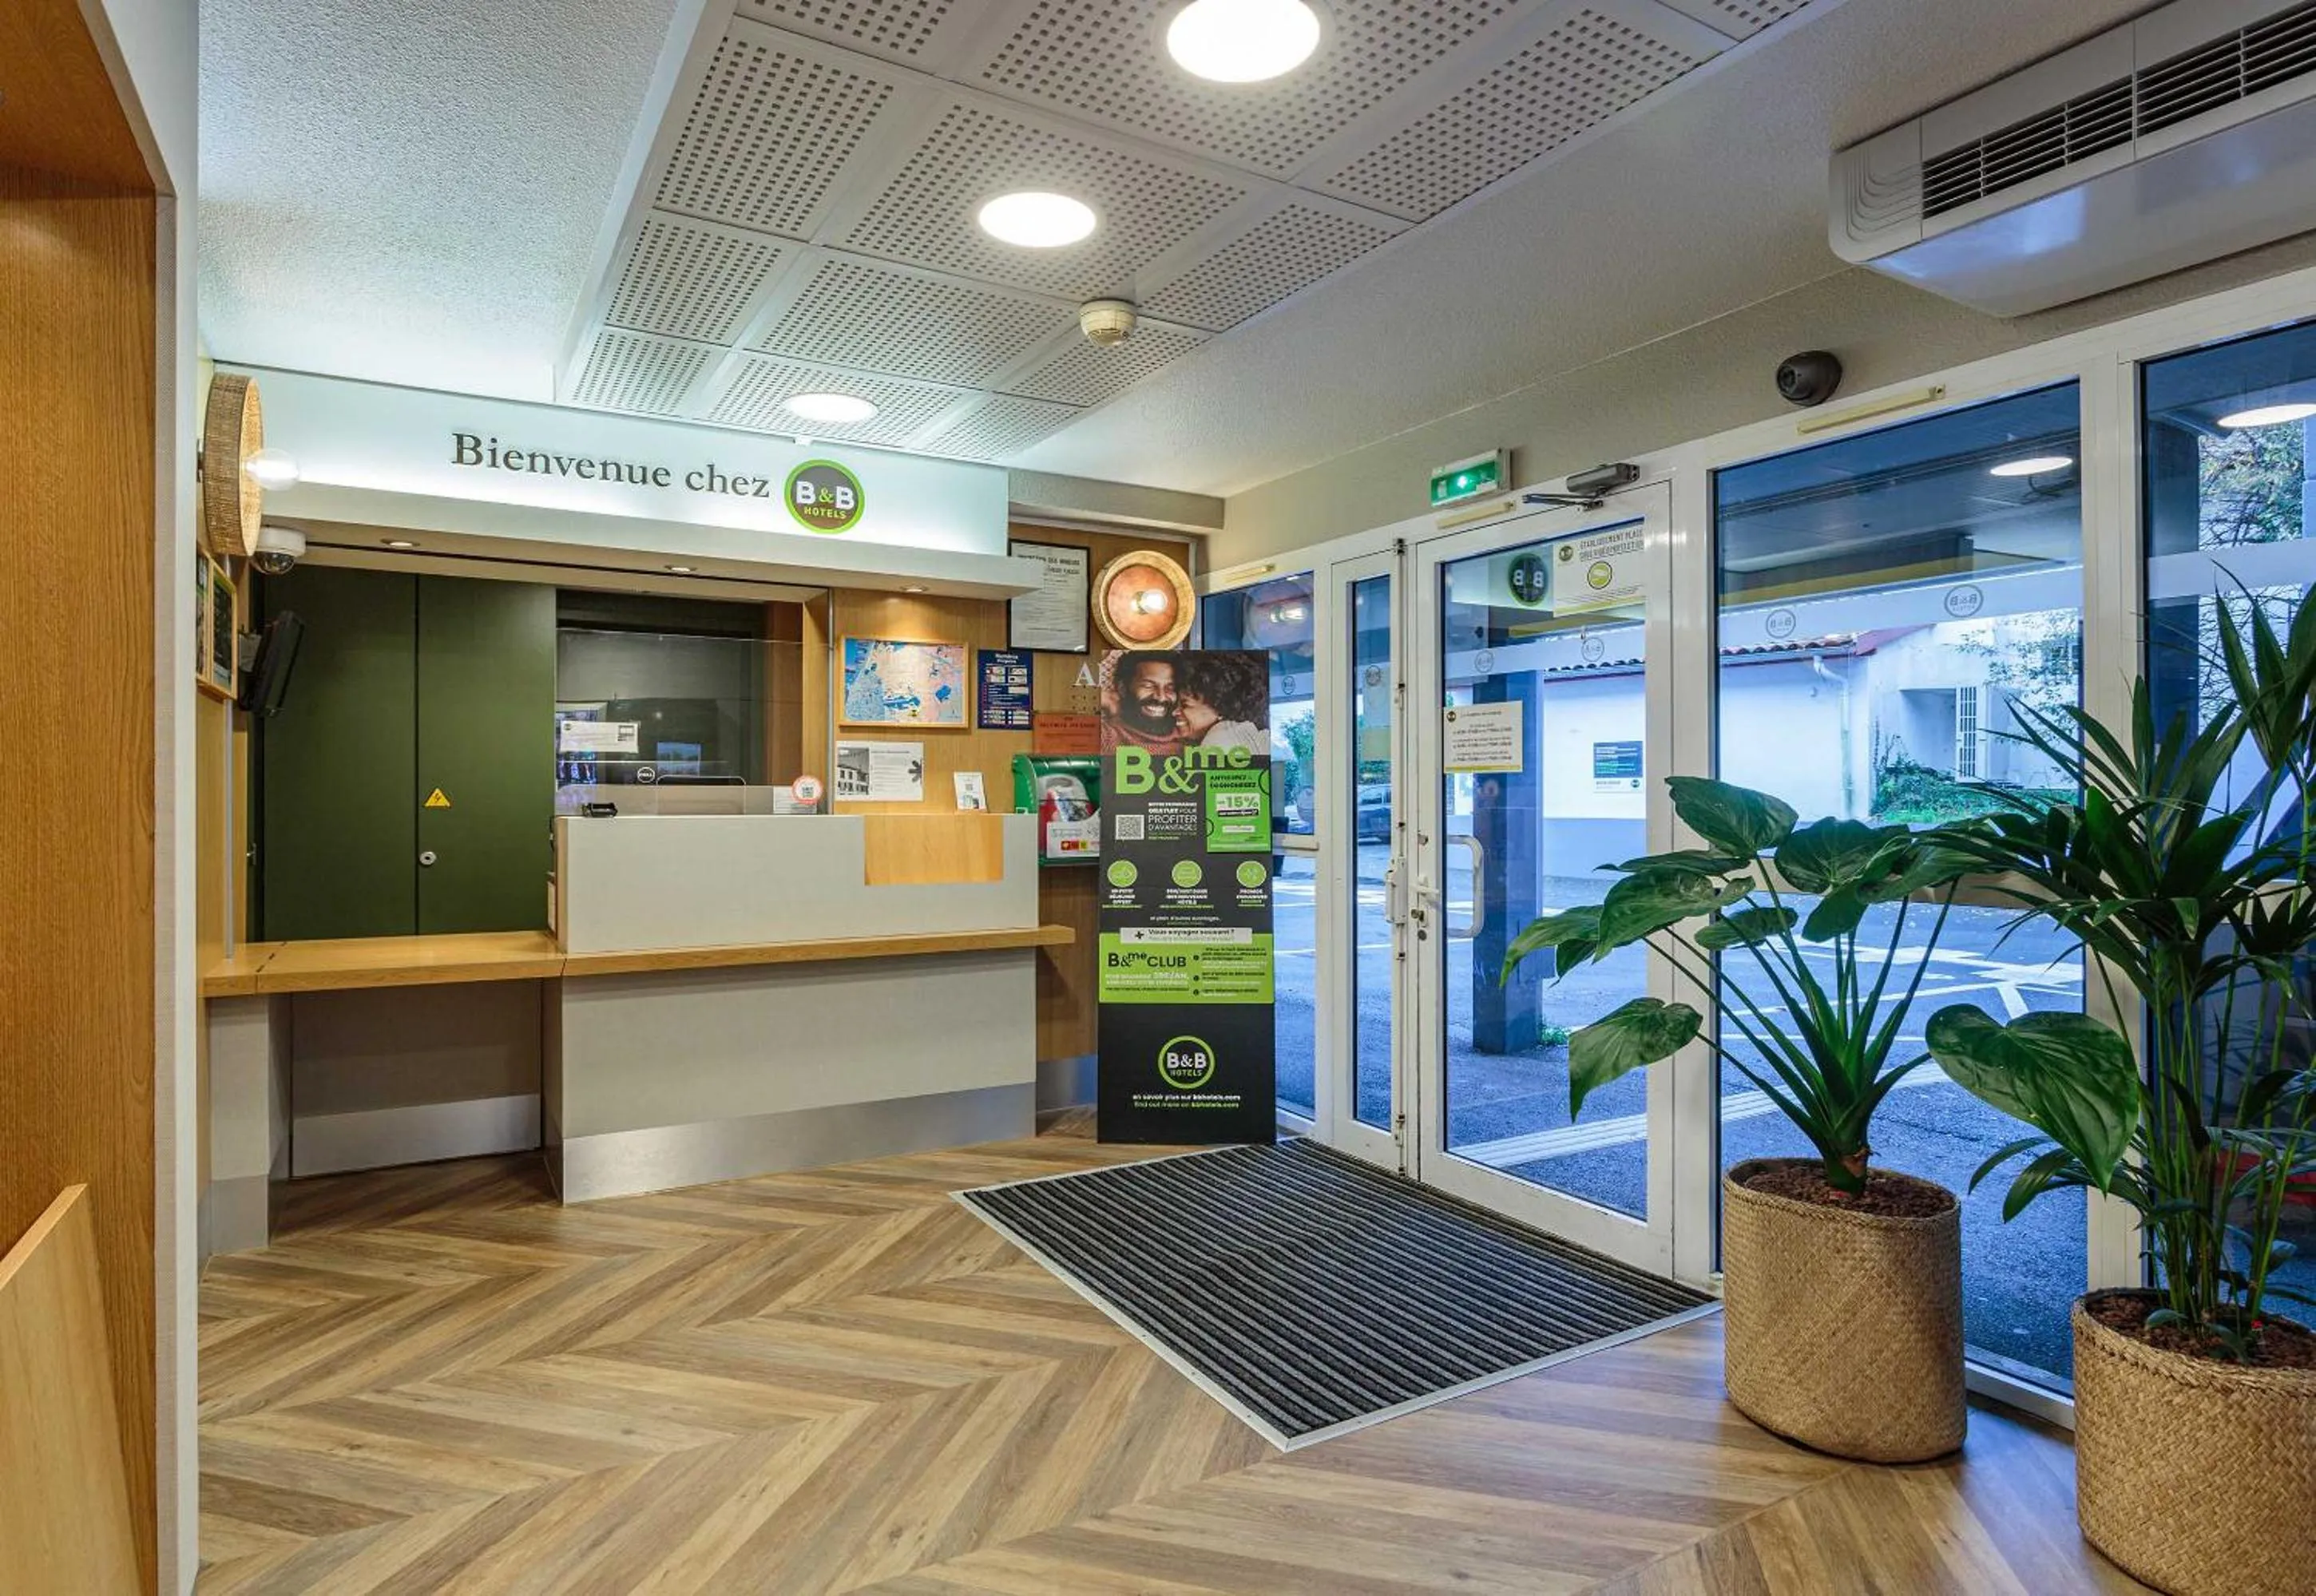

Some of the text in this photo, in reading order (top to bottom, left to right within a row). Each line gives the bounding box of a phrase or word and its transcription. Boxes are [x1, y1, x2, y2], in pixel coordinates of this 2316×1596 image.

[452, 433, 770, 498] Bienvenue chez
[796, 481, 854, 509] B&B
[803, 506, 847, 519] HOTELS
[1073, 661, 1101, 687] A
[1218, 795, 1259, 809] -15%
[1147, 956, 1187, 968] CLUB
[1166, 1051, 1207, 1069] B&B
